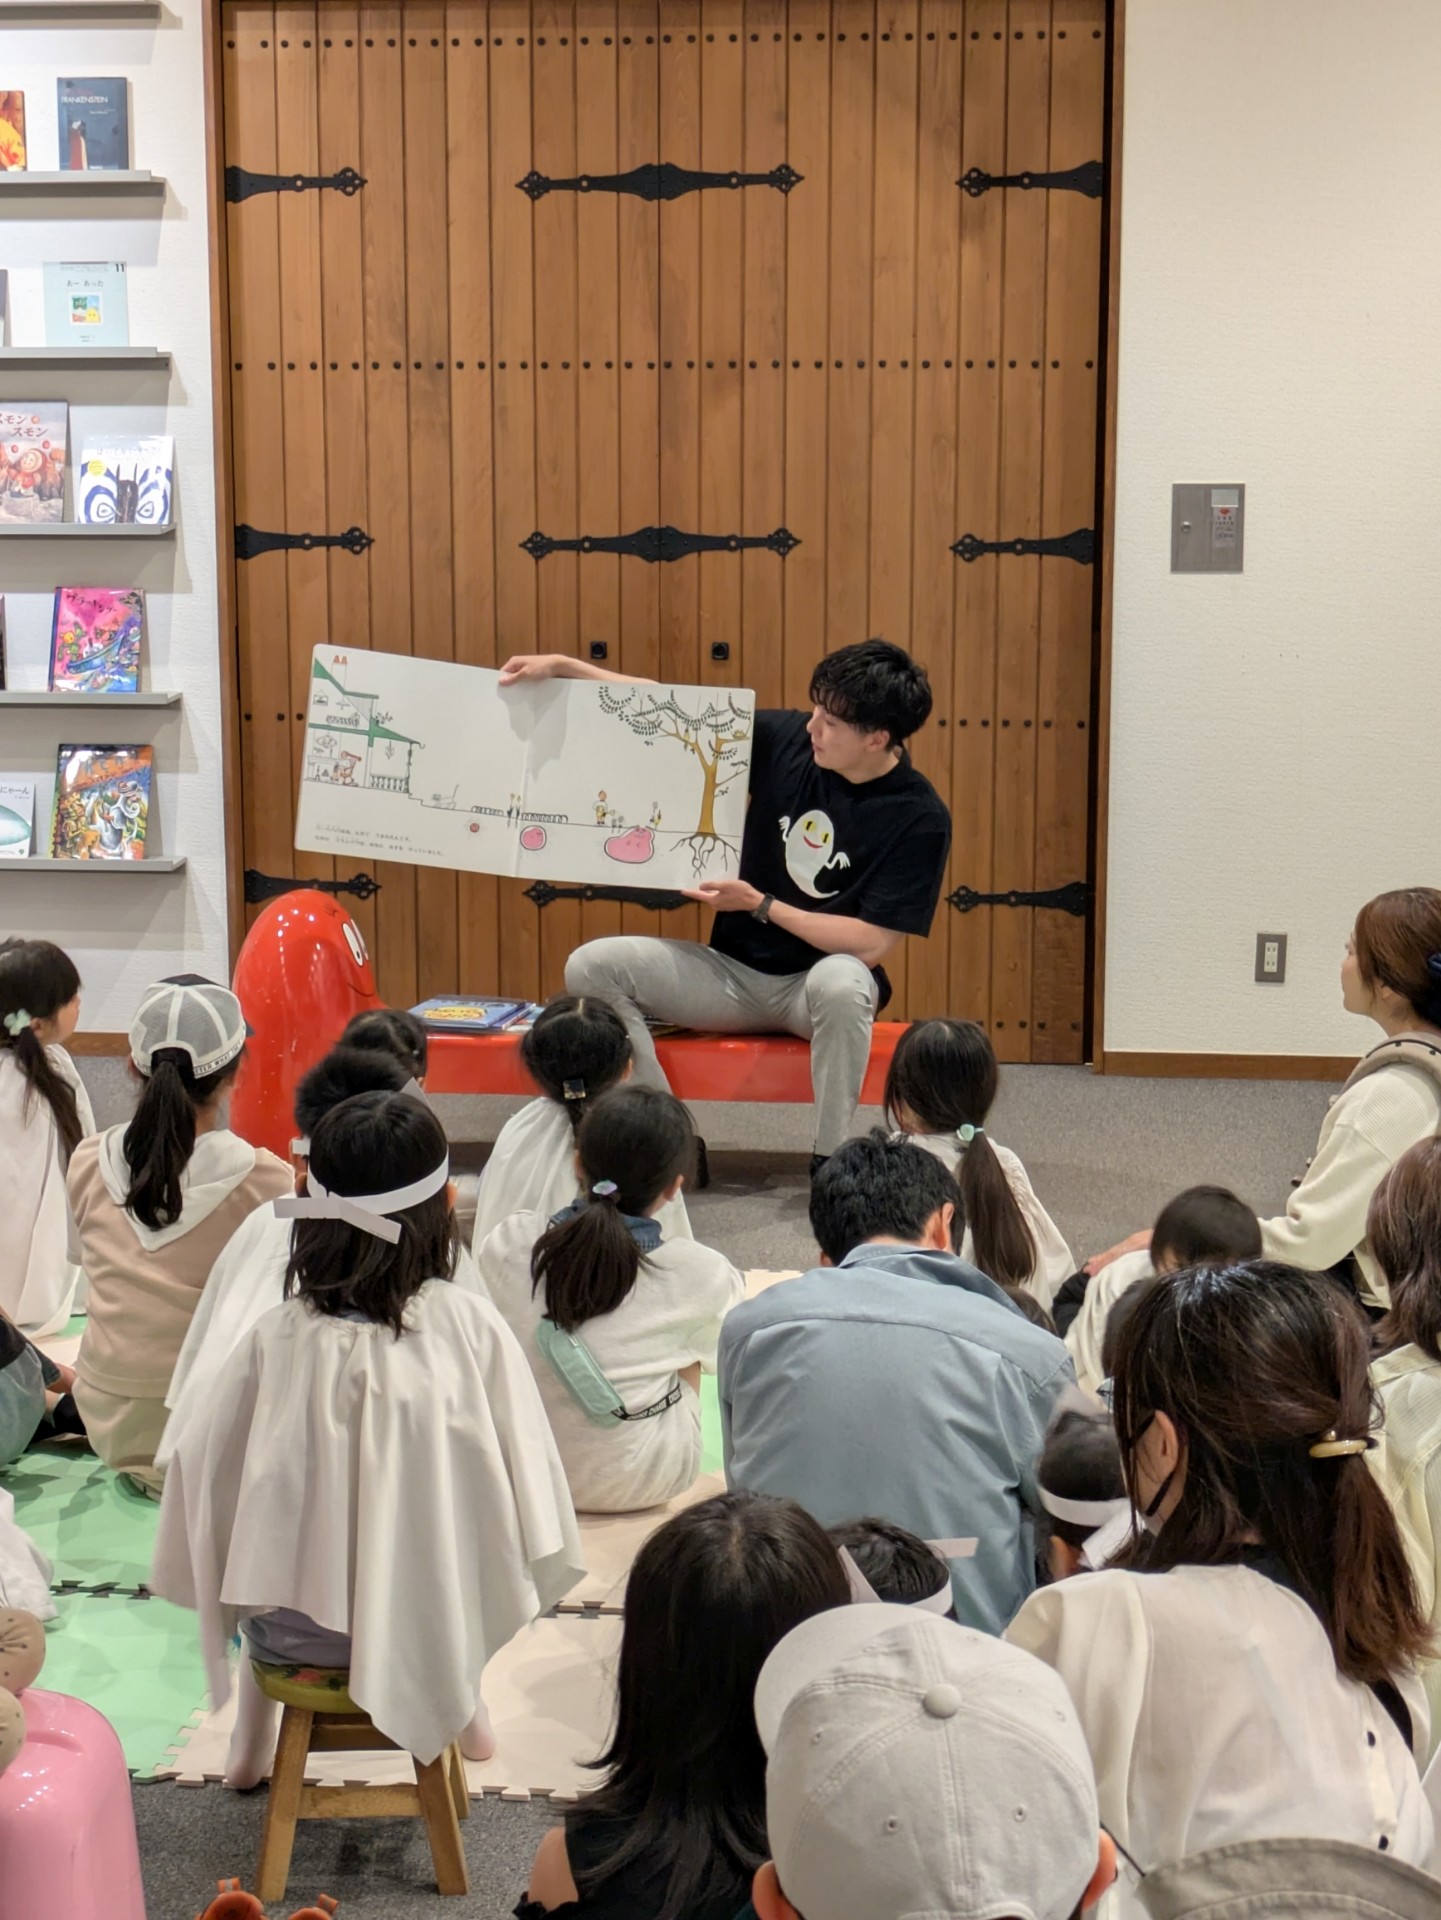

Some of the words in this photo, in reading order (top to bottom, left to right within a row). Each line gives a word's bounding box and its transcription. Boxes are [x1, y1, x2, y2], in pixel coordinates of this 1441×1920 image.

[115, 263, 125, 272] 11
[11, 427, 49, 437] スモン
